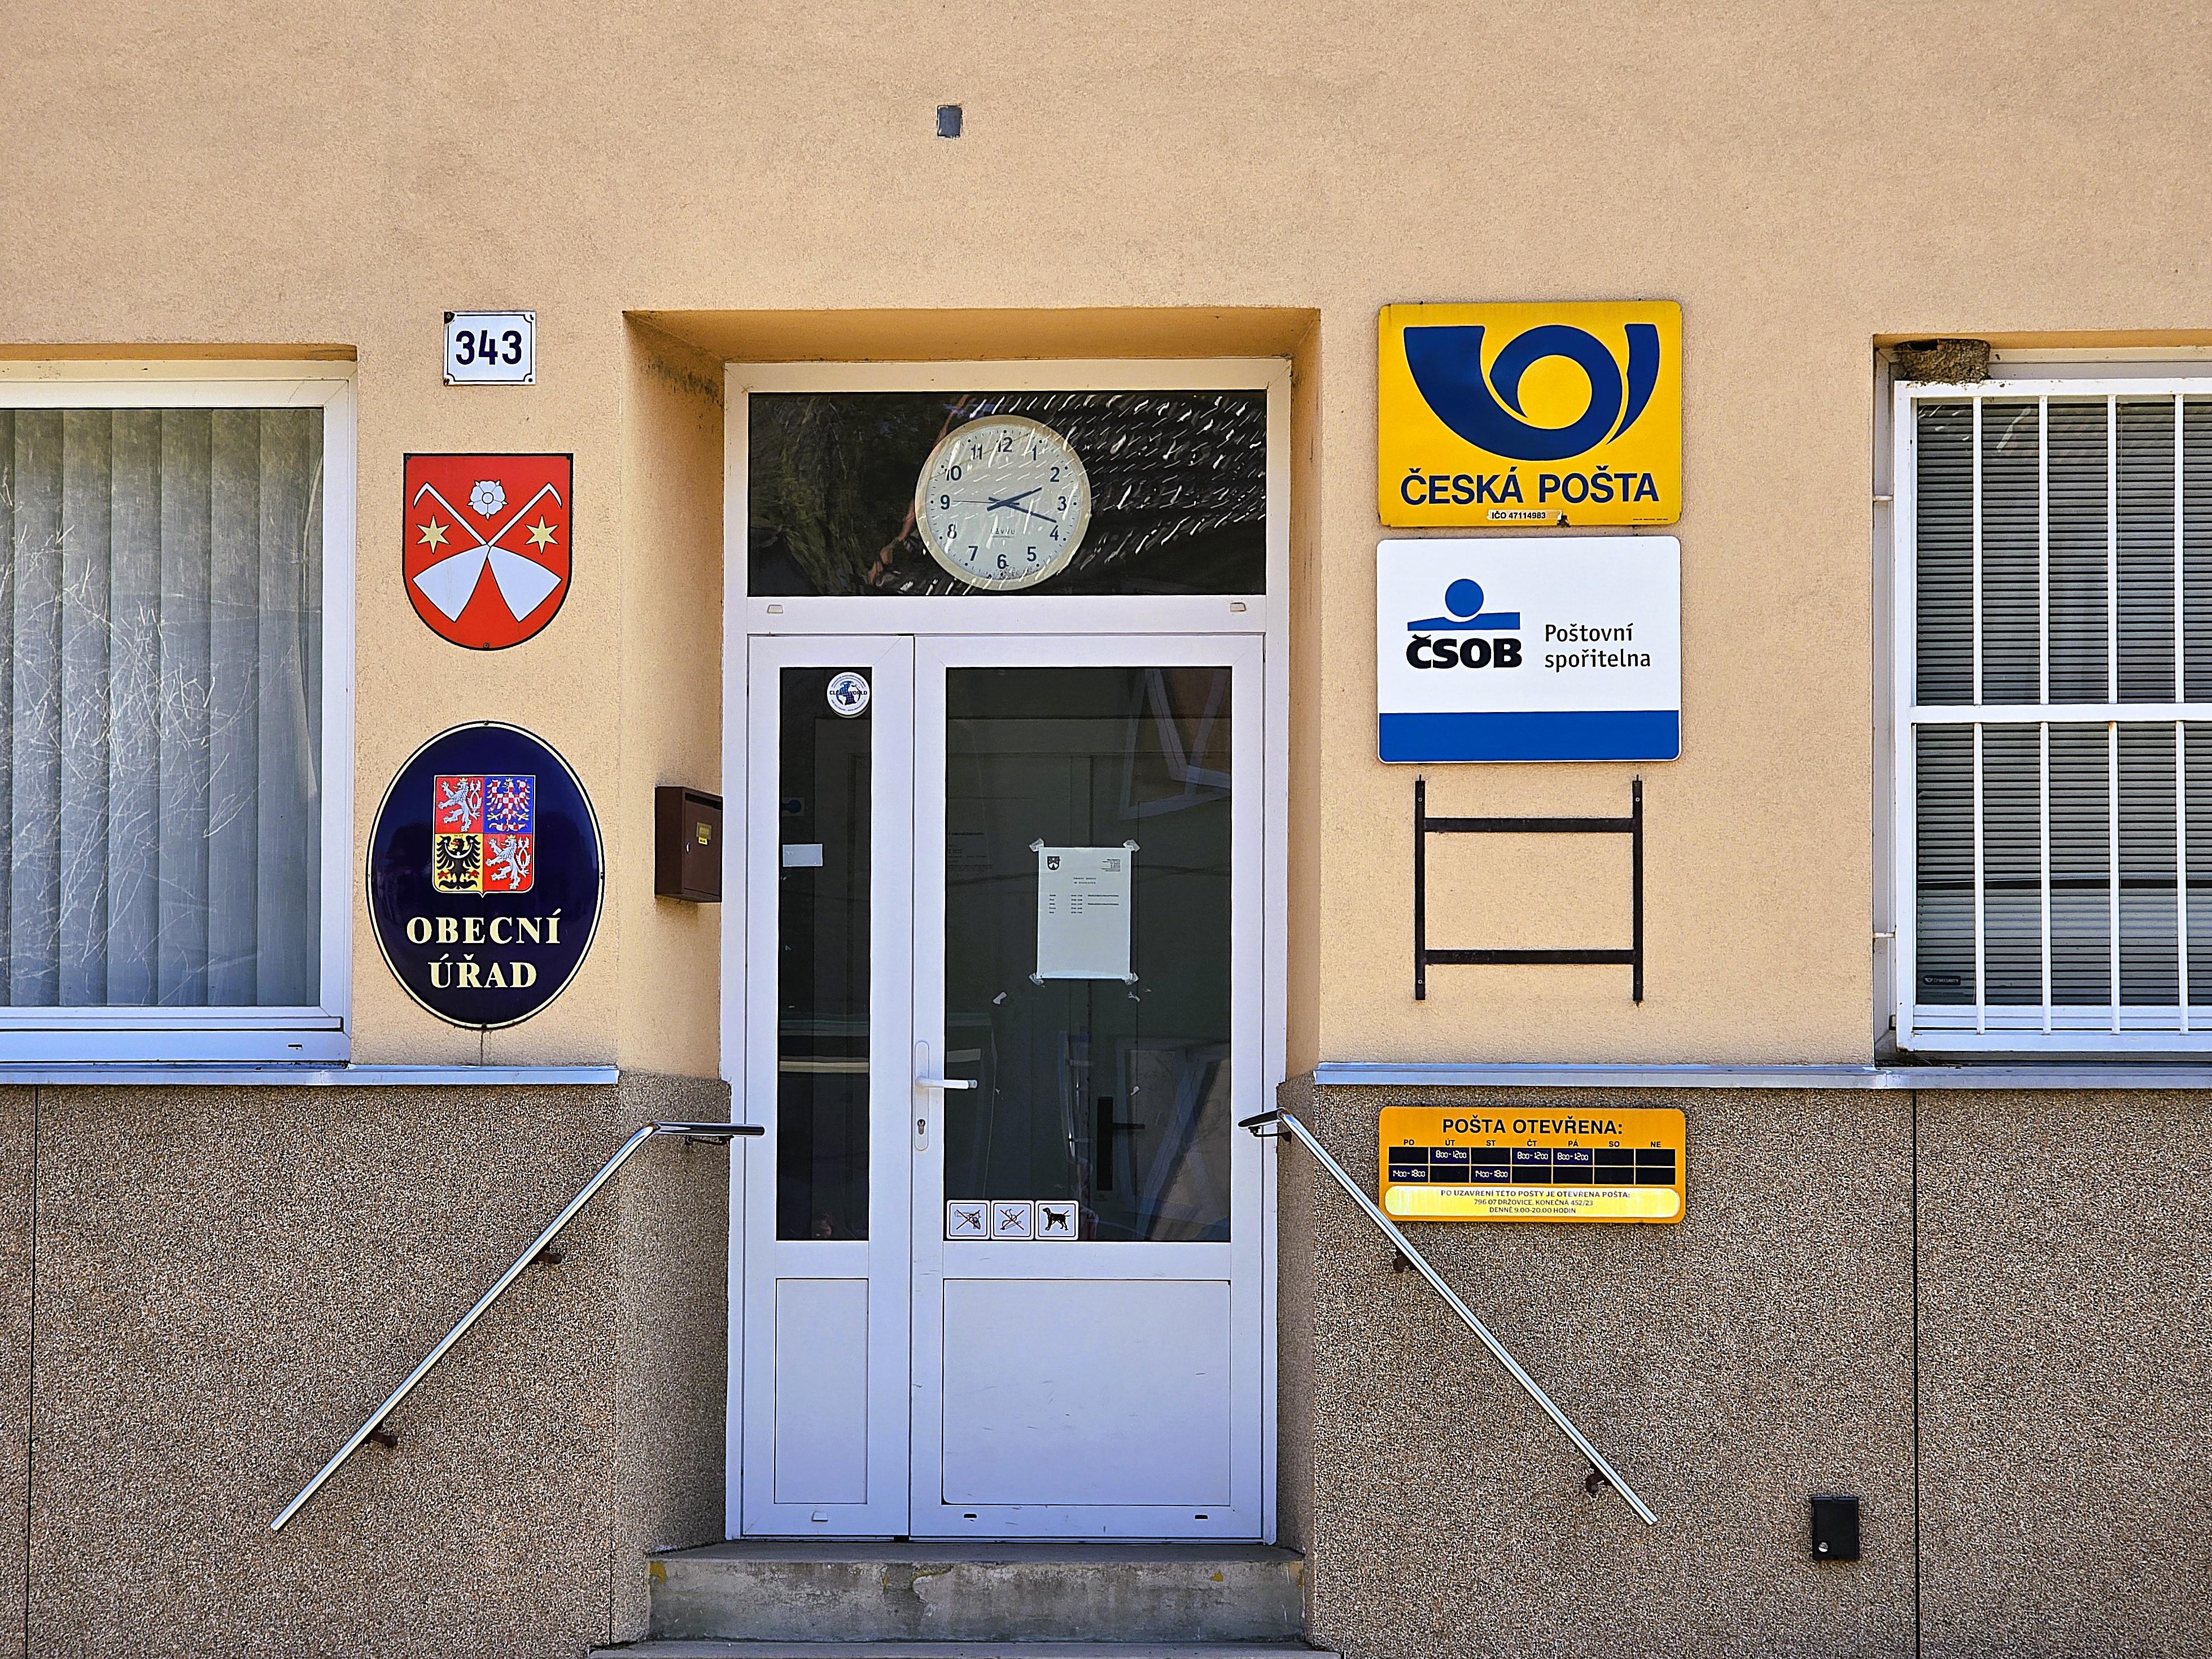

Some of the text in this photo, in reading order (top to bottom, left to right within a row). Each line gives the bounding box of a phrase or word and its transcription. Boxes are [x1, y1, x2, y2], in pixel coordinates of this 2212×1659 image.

[456, 330, 522, 365] 343
[971, 444, 982, 460] 11
[998, 437, 1012, 452] 12
[1032, 445, 1037, 460] 1
[946, 465, 961, 481] 10
[1050, 467, 1060, 482] 2
[1401, 465, 1660, 505] ČESKÁ POŠTA
[940, 495, 950, 510] 9
[1057, 496, 1067, 511] 3
[947, 524, 957, 539] 8
[1050, 525, 1059, 540] 4
[968, 545, 978, 561] 7
[1027, 547, 1037, 561] 5
[997, 554, 1007, 569] 6
[1545, 623, 1634, 642] Poštovní
[1406, 634, 1523, 669] ČSOB
[1545, 648, 1651, 673] spořitelna
[406, 909, 561, 944] OBECNÍ
[428, 953, 537, 988] ÚŘAD
[1443, 1115, 1622, 1134] POŠTA OTEVŘENA:
